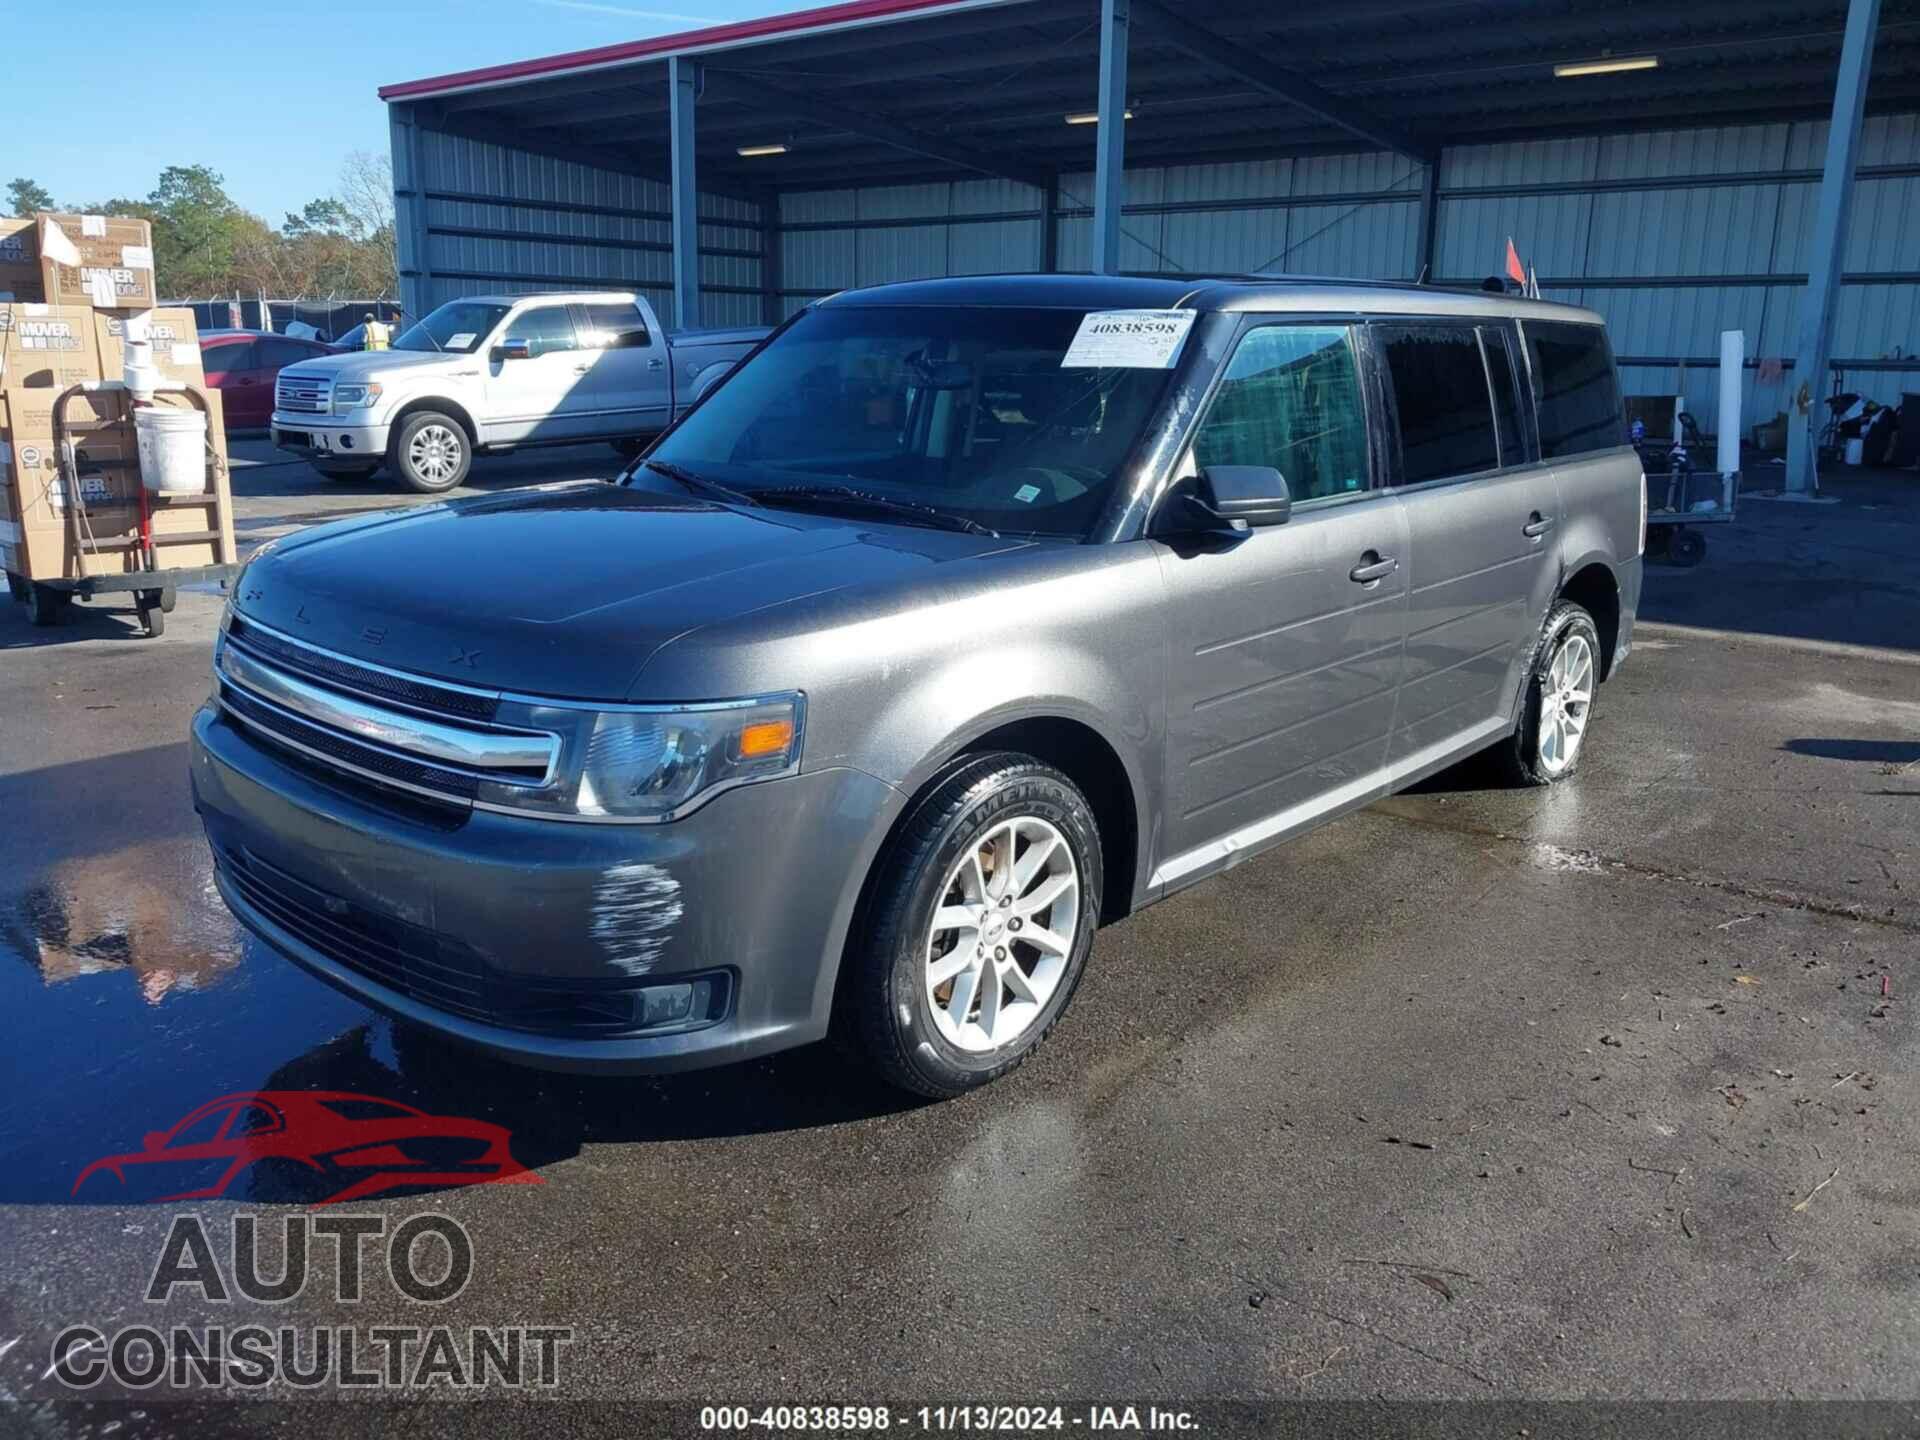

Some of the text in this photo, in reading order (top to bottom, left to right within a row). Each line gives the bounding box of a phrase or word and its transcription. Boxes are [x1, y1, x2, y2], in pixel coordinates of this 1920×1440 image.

[80, 267, 134, 284] MER
[19, 321, 71, 337] MOVER
[1088, 322, 1177, 335] 40838598
